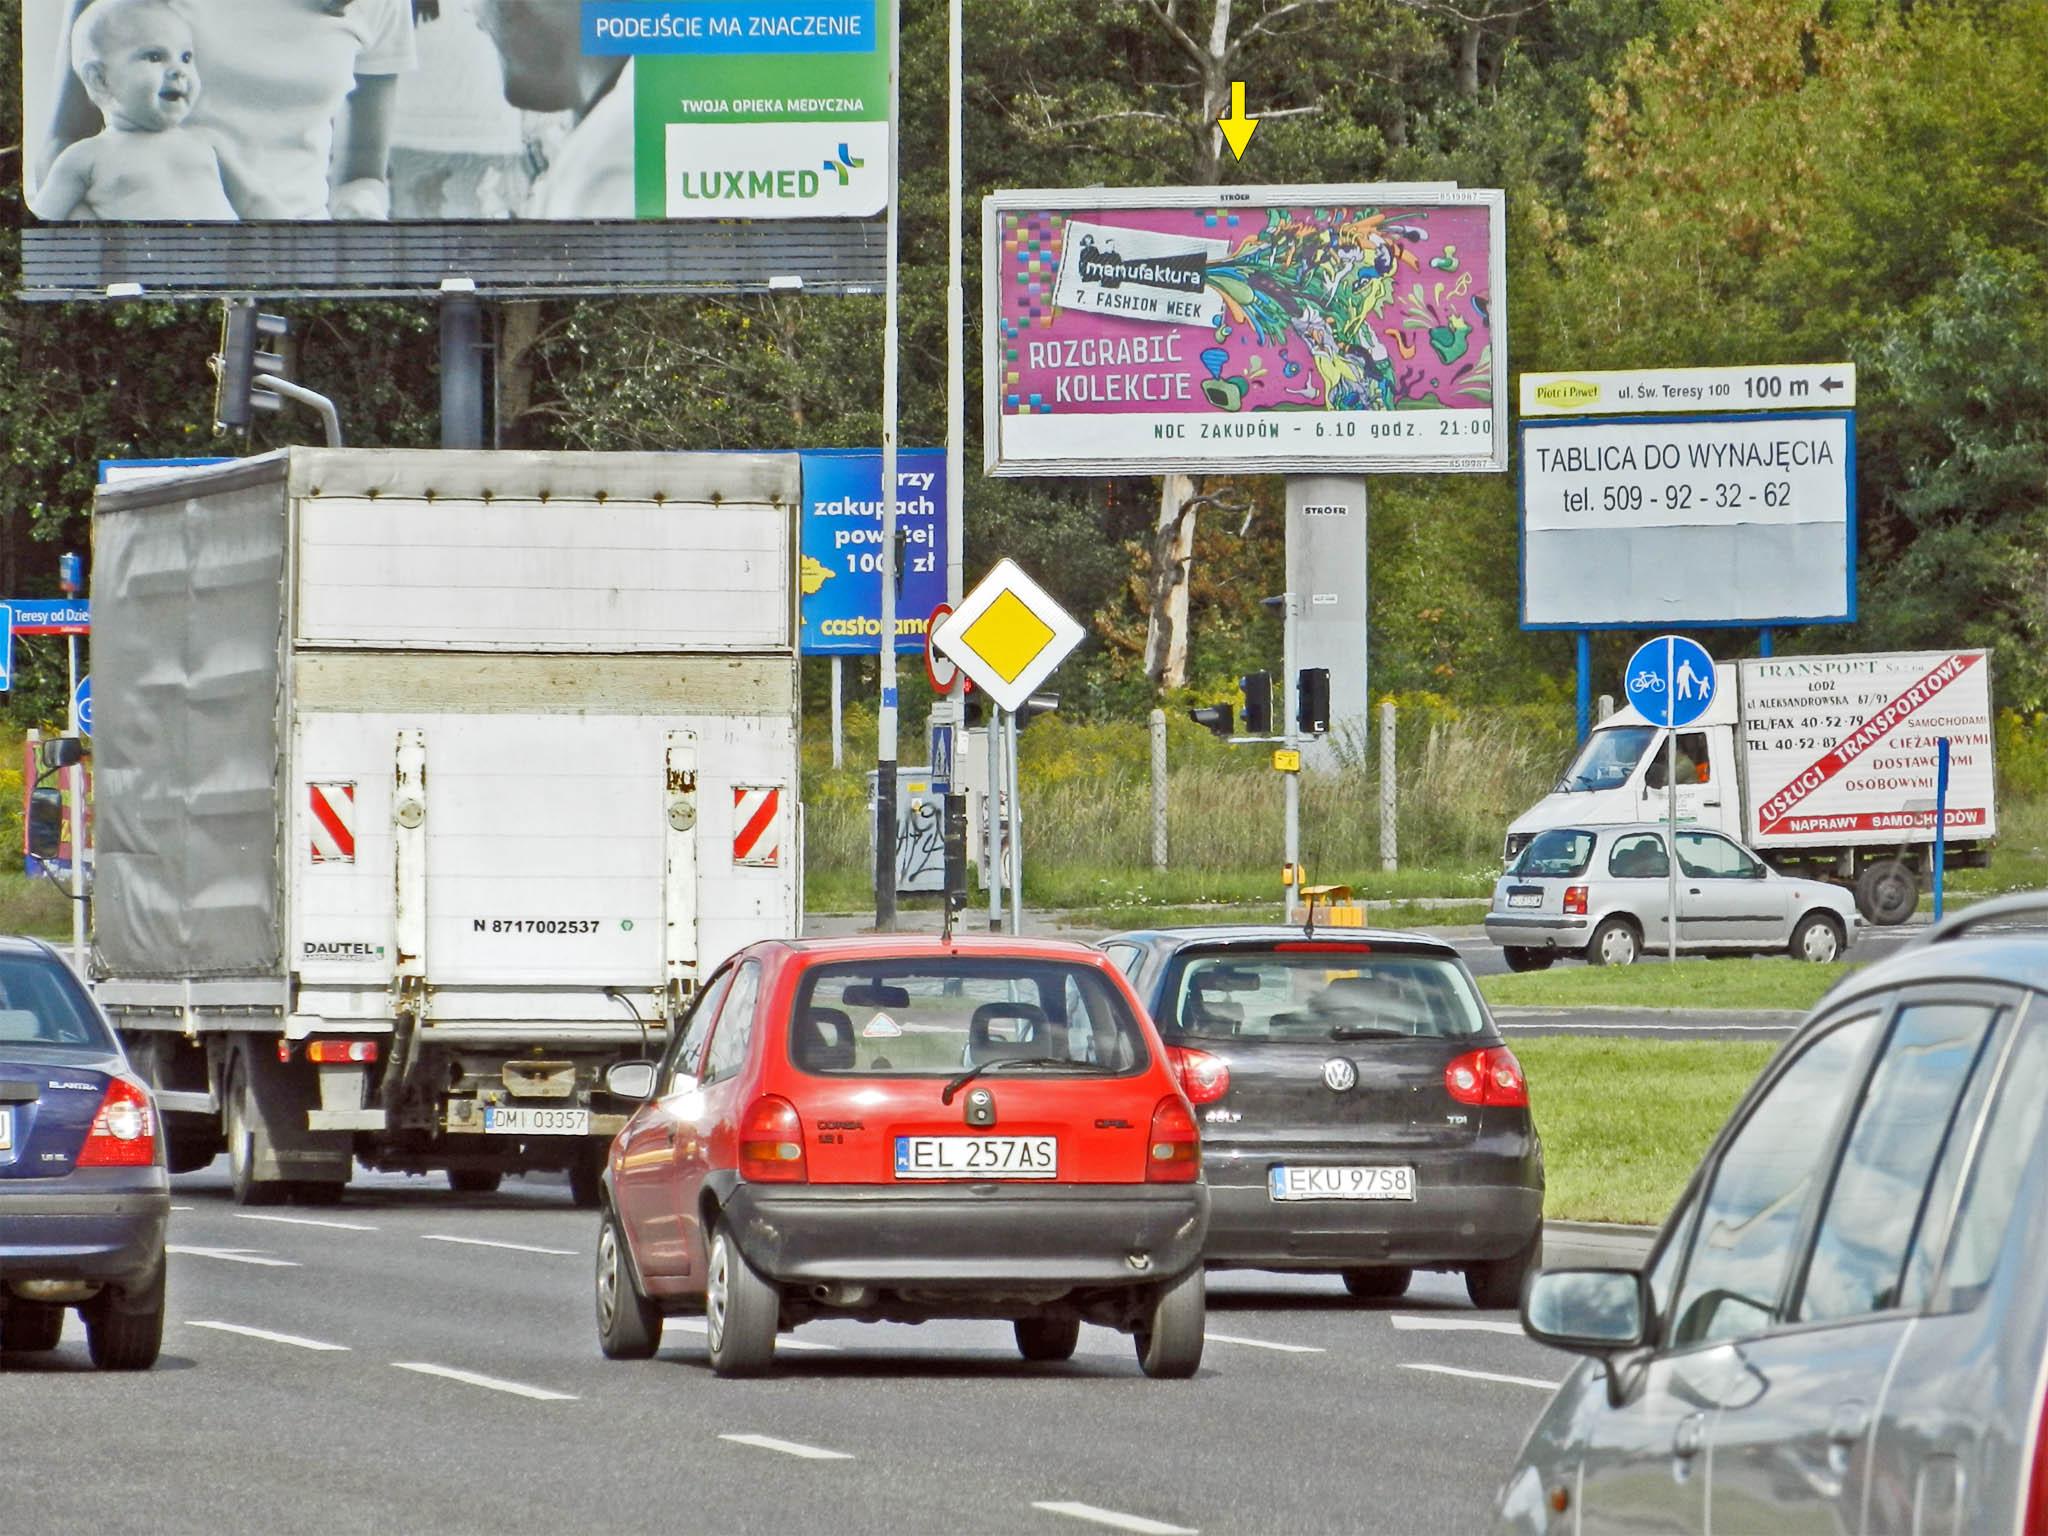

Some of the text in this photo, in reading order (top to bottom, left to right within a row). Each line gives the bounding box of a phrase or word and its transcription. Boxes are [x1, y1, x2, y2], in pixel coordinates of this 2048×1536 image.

[595, 13, 861, 38] PODEJŚCIE MA ZNACZENIE
[682, 98, 864, 113] TWOJA OPIEKA MEDYCZNA
[682, 169, 820, 199] LUXMED
[1085, 259, 1201, 286] manufaktura
[1076, 289, 1202, 318] 7. FASHION WEEK
[1028, 328, 1182, 369] ROZGRABIĆ
[1056, 373, 1191, 402] KOLEKCJE
[1618, 382, 1731, 401] ul. Św. Teresy 100
[1744, 376, 1809, 398] 100 m
[1154, 424, 1185, 439] NOC
[1200, 419, 1280, 439] ZAKUPÓW
[1315, 421, 1356, 437] 6.10
[1370, 420, 1423, 439] godz.
[1439, 420, 1491, 435] 21:00
[1536, 440, 1834, 473] TABLICA DO WYNAJĘCIA
[1563, 486, 1595, 512] tel.
[1603, 484, 1643, 510] 509
[1665, 483, 1692, 509] 92
[1715, 482, 1742, 508] 32
[1763, 481, 1791, 507] 62
[913, 552, 935, 572] zł
[15, 609, 48, 625] Teresy
[50, 608, 64, 622] od
[1759, 660, 1878, 678] TRANSPORT
[1759, 695, 1849, 709] ALEKSANDROWSKA
[1833, 655, 1967, 765] TRANSPORTOWE
[1746, 717, 1795, 731] TEL/FAX
[1747, 739, 1769, 751] TEL
[1873, 757, 1973, 770] DOSTAWCYMI
[1762, 764, 1827, 822] USŁUGI
[1845, 776, 1933, 791] OSOBOWYMI
[1790, 817, 1858, 831] NAPRAWY
[473, 919, 600, 934] N 8717002537
[304, 942, 373, 954] DAUTEL
[496, 1110, 587, 1130] DMI 03357
[1447, 1115, 1467, 1124] TDI
[915, 1141, 1051, 1168] EL 257AS
[1290, 1170, 1407, 1191] EKU 97S8
